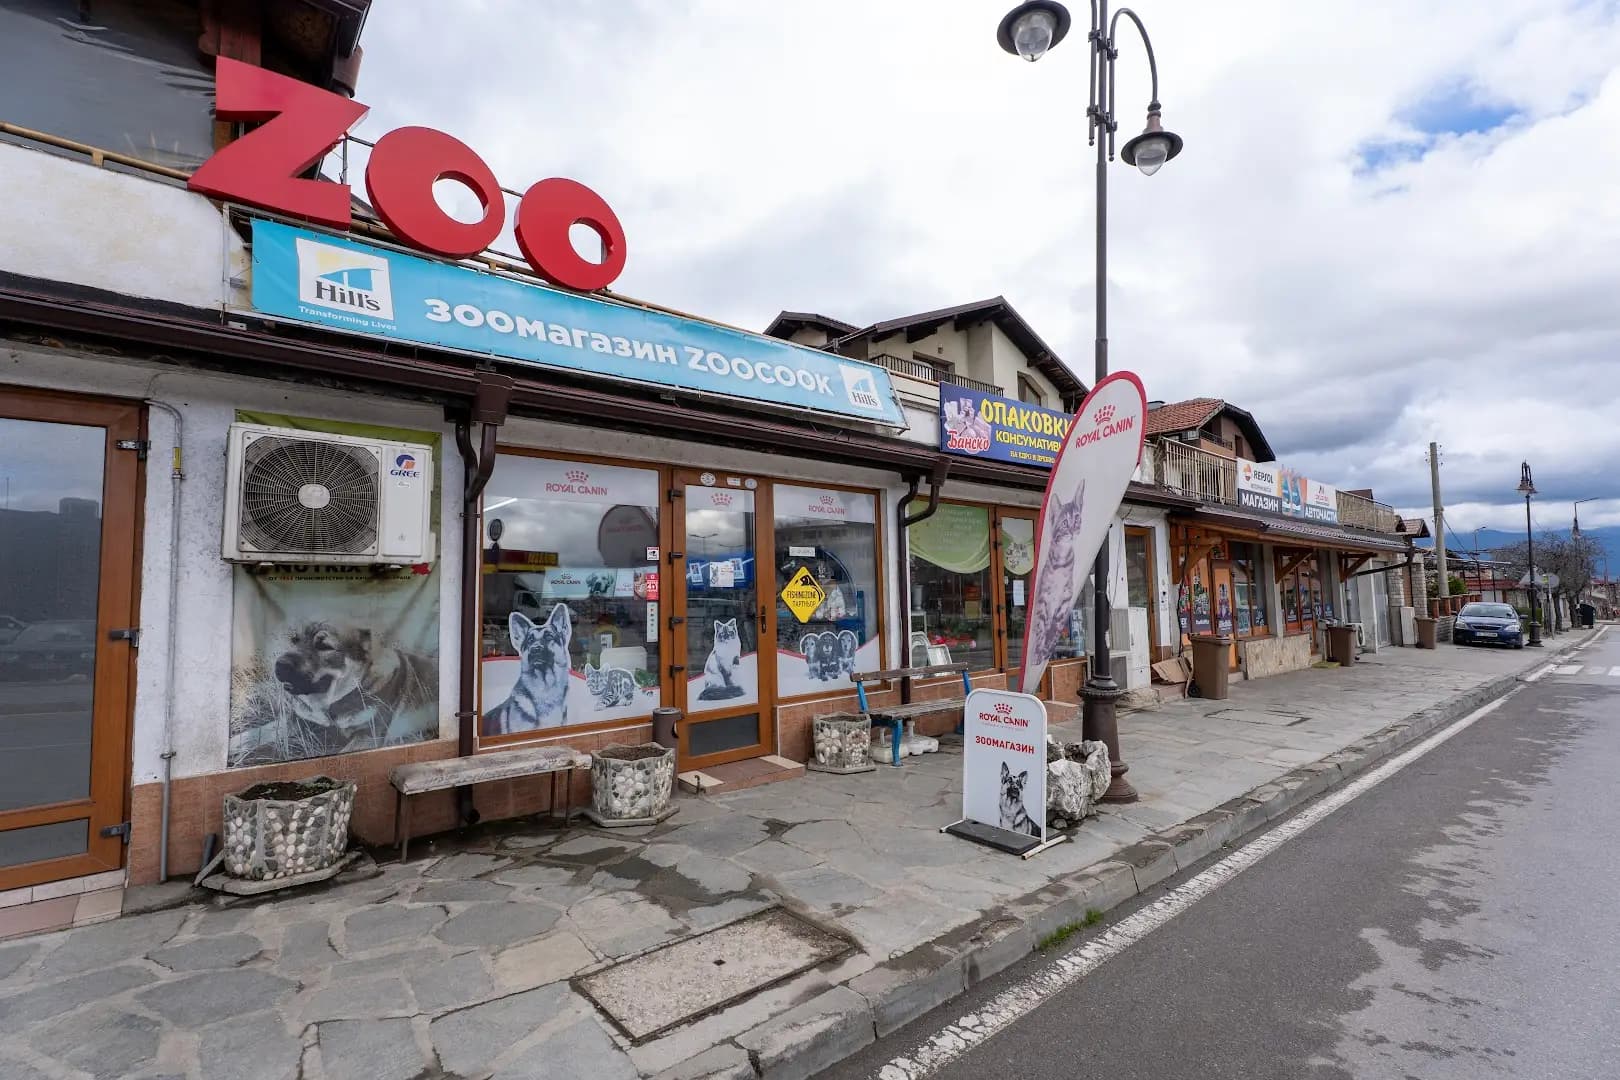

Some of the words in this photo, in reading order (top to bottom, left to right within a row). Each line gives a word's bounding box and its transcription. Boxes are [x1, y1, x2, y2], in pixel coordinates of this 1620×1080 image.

[316, 281, 381, 311] Hill's
[299, 306, 369, 326] Transforming
[371, 321, 397, 331] Lives
[684, 346, 833, 396] ZOOCOOK
[852, 391, 878, 407] Hill's
[1076, 429, 1101, 449] ROYAL
[1103, 417, 1134, 440] CANIN
[390, 469, 420, 478] GREE
[1253, 470, 1274, 484] REPSOL
[545, 483, 575, 494] ROYAL
[578, 486, 608, 496] CANIN
[1242, 492, 1279, 512] МАГАЗИН
[979, 712, 1002, 724] ROYAL
[1004, 717, 1029, 728] CANIN
[975, 736, 1035, 754] ЗООМАГАЗИН
